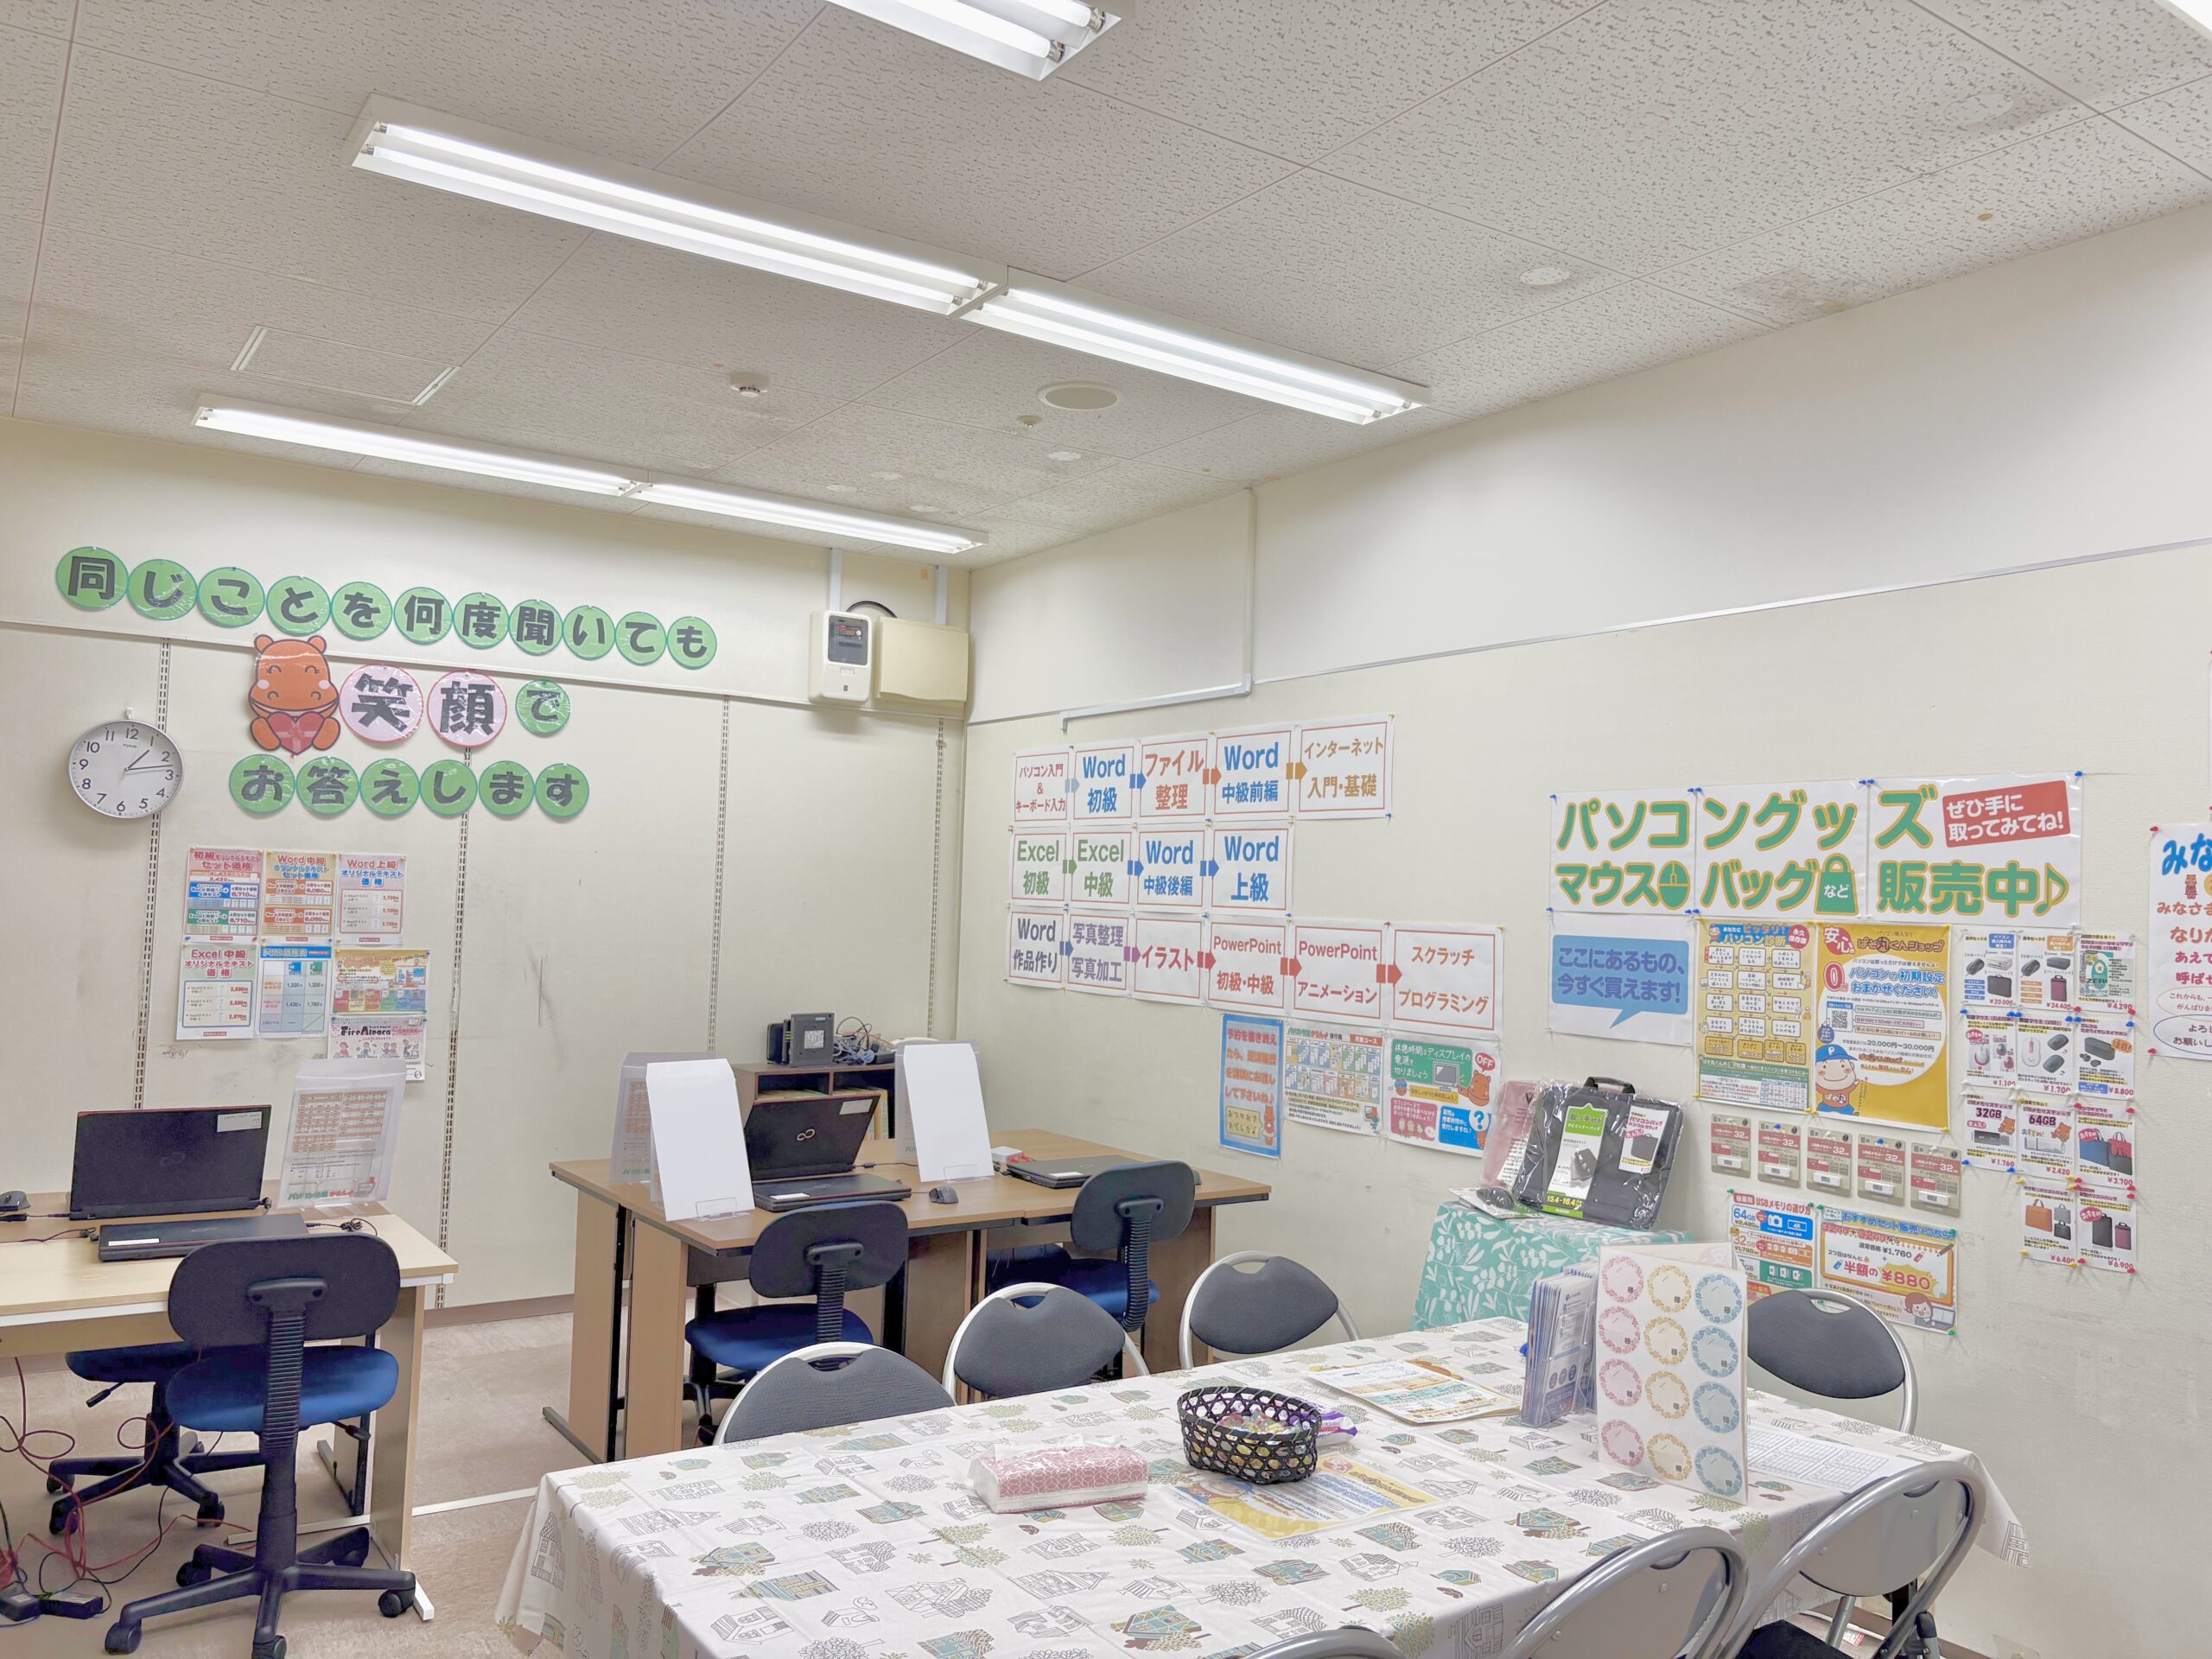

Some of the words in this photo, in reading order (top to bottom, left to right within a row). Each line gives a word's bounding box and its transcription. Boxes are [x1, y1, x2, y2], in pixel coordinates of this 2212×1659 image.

[67, 554, 708, 659] 同じことを何度聞いても
[350, 677, 562, 736] 笑顔で
[105, 730, 115, 741] 11
[125, 728, 138, 740] 12
[150, 736, 154, 747] 1
[86, 741, 100, 753] 10
[162, 752, 170, 762] 2
[1224, 741, 1279, 771] Word
[1305, 737, 1383, 760] インターネット
[79, 760, 88, 770] 9
[1020, 764, 1064, 778] パソコン入門
[1083, 753, 1126, 779] Word
[1145, 749, 1205, 777] ファイル
[82, 779, 91, 789] 8
[165, 770, 174, 780] 3
[241, 763, 582, 809] お答えします
[1307, 774, 1377, 799] 入門・基礎
[97, 793, 107, 804] 7
[156, 788, 165, 798] 4
[1037, 783, 1044, 795] &
[1087, 787, 1117, 813] 初級
[1155, 784, 1188, 810] 整理
[1222, 780, 1279, 804] 中級前編
[117, 801, 125, 811] 6
[139, 798, 149, 809] 5
[1015, 798, 1065, 812] キーボード入力
[1946, 793, 2023, 820] ぜひ手に
[1556, 784, 1939, 851] パソコングッズ
[1948, 810, 2064, 842] 取ってみてね!
[1017, 840, 1059, 862] Excel
[1077, 839, 1124, 862] Excel
[1146, 840, 1193, 864] Word
[1224, 836, 1280, 862] Word
[347, 860, 375, 868] Word
[1022, 871, 1049, 895] 初級
[1084, 872, 1114, 898] 中級
[1143, 875, 1193, 897] 中級後編
[1230, 873, 1269, 902] 上級
[1554, 860, 1662, 906] マウス
[1700, 859, 1819, 910] バッグ
[1824, 884, 1849, 899] など
[1876, 859, 2041, 918] 販売中
[1018, 918, 1056, 941] Word
[1072, 922, 1123, 948] 写真整理
[191, 950, 220, 958] Excel
[1213, 936, 1282, 955] PowerPoint
[1299, 940, 1377, 961] PowerPoint
[1411, 946, 1474, 967] スクラッチ
[1013, 949, 1058, 975] 作品作り
[1071, 957, 1122, 982] 写真加工
[1141, 946, 1194, 972] イラスト
[1558, 947, 1685, 976] ここにあるもの、
[1217, 970, 1274, 995] 初級・中級
[1849, 967, 1945, 984] パソコンの初期設定
[1297, 981, 1377, 1004] アニメーション
[1557, 972, 1681, 1003] 今すぐ買えます!
[1399, 990, 1489, 1015] プログラミング
[1476, 1054, 1494, 1068] OFF
[1976, 1108, 2002, 1119] 32GB
[2029, 1115, 2056, 1126] 64GB
[1733, 1208, 1756, 1221] 64GB
[1733, 1236, 1756, 1249] 32GB
[1844, 1261, 1878, 1278] 半額の
[1882, 1268, 1930, 1289] ¥880
